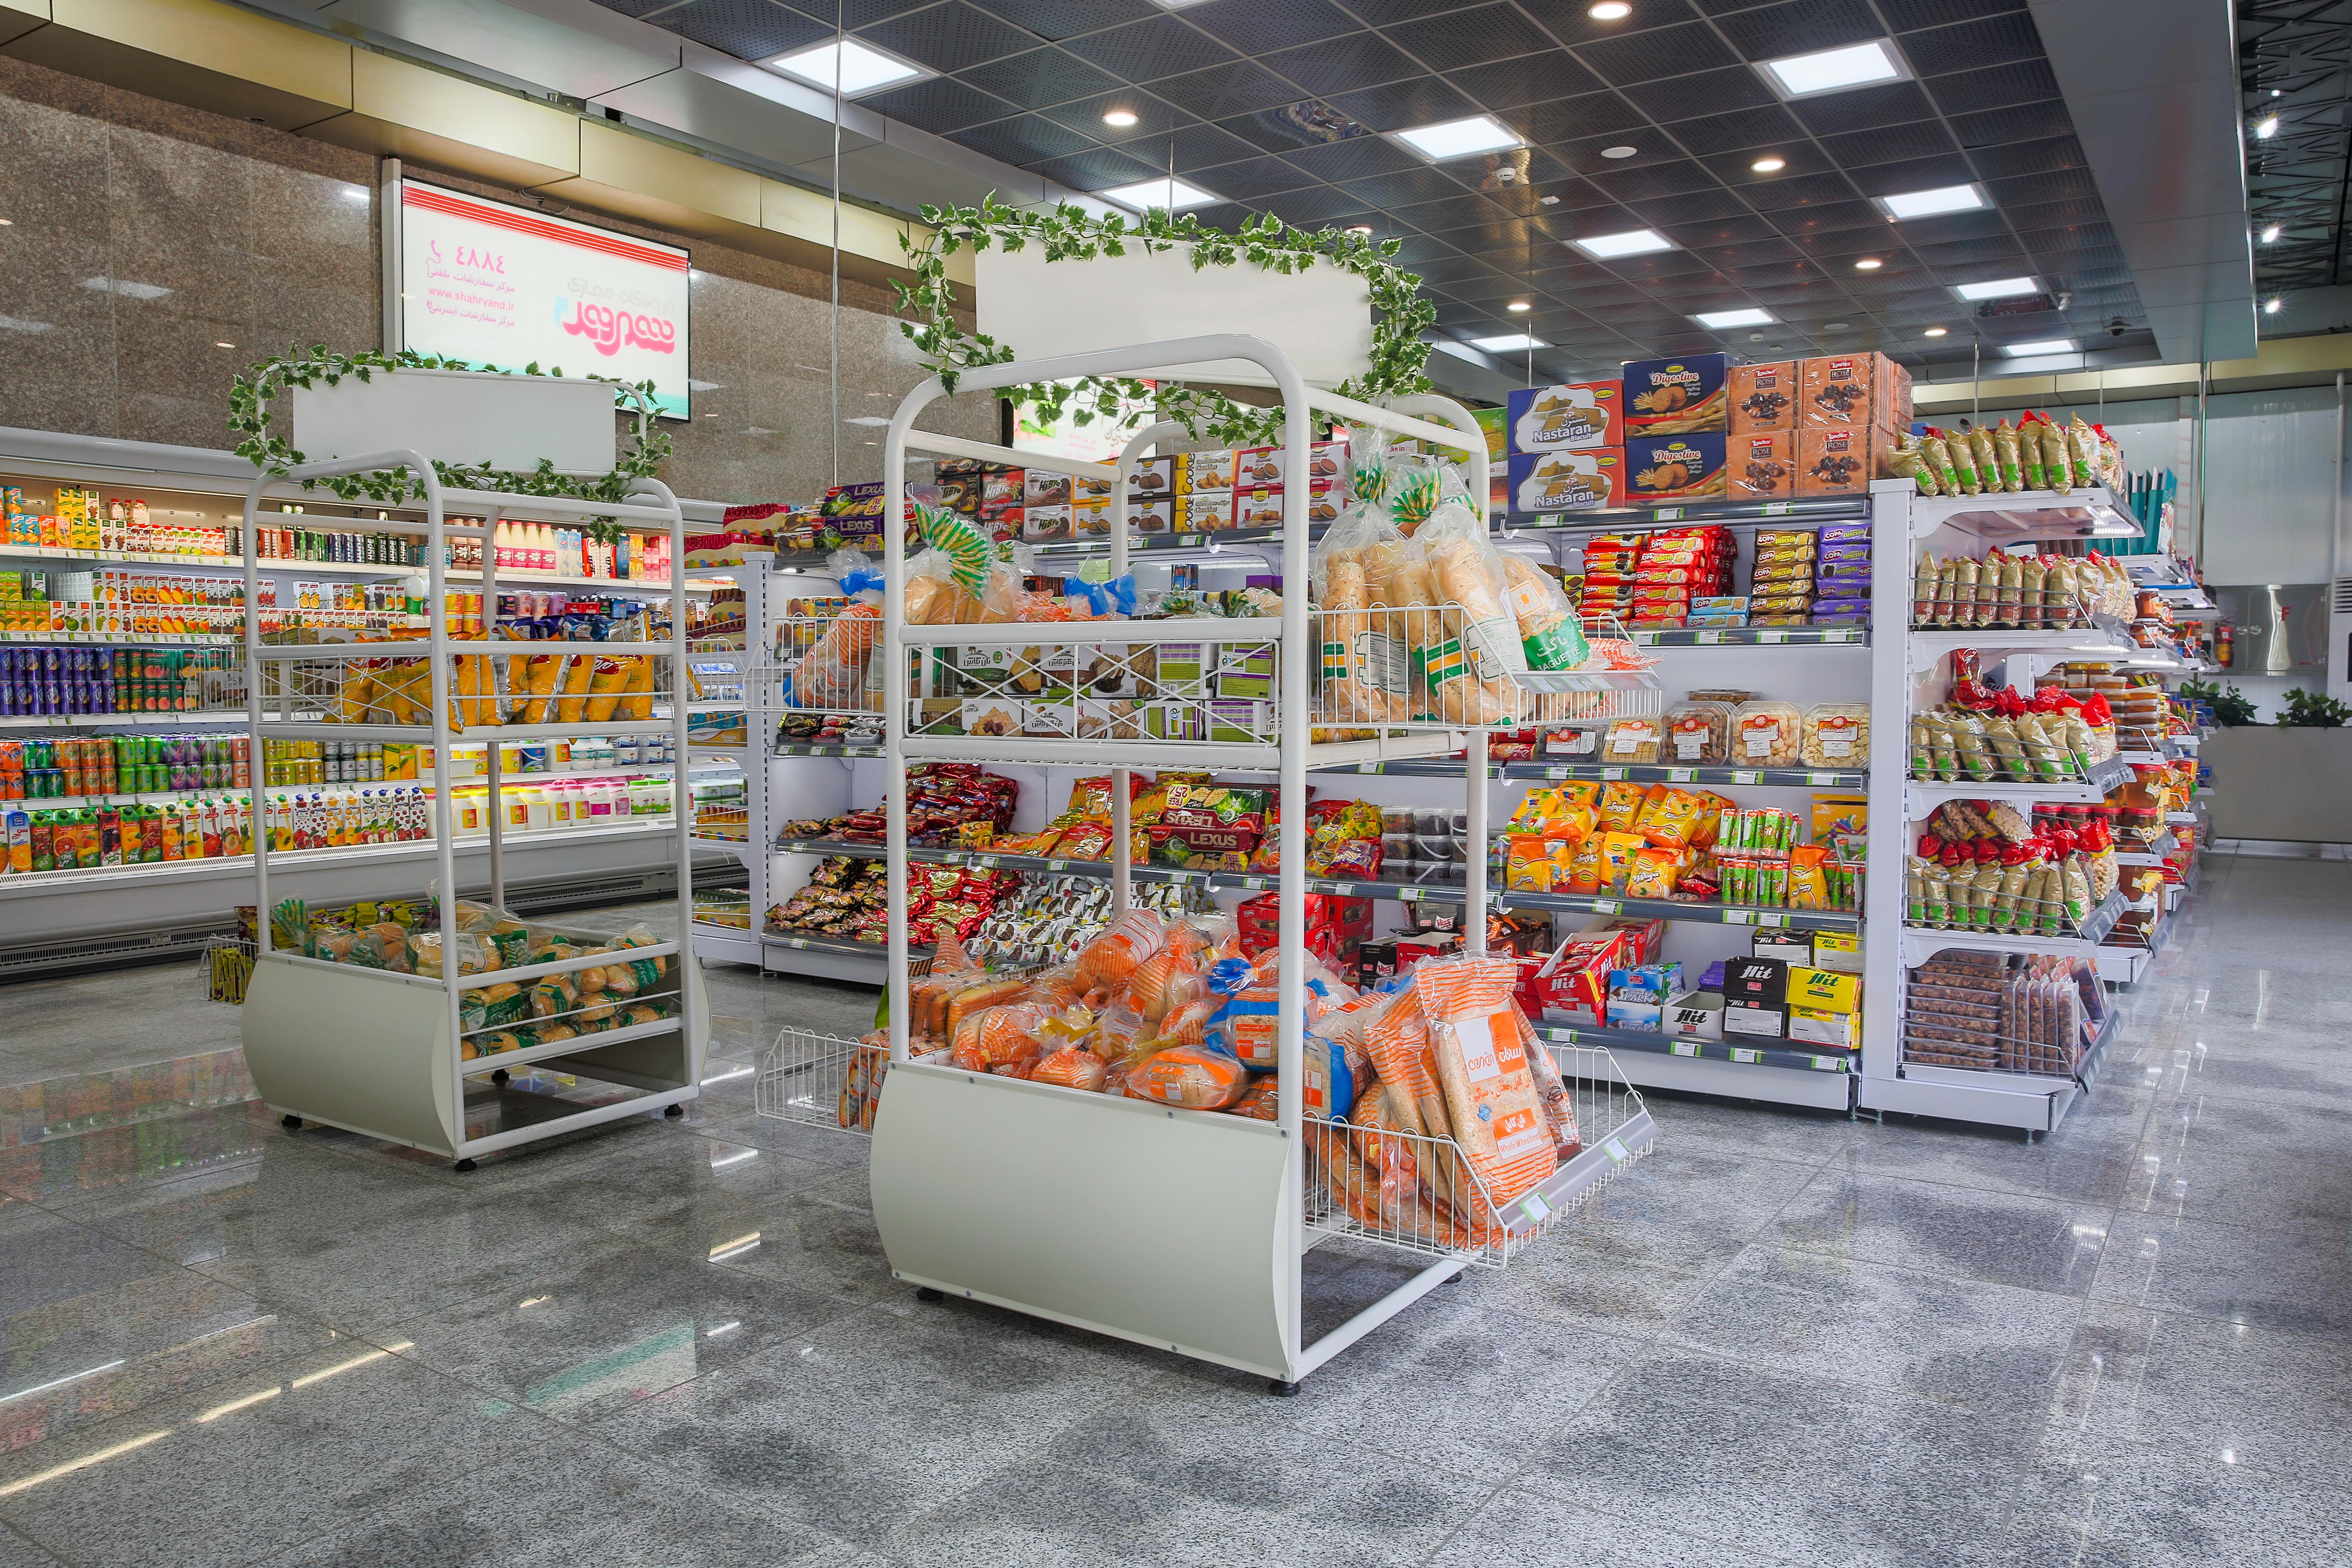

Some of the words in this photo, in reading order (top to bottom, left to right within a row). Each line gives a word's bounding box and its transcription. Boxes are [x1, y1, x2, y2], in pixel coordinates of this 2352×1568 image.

[428, 269, 450, 278] تلفنی
[453, 274, 494, 287] سفارشات
[496, 282, 515, 293] مرکز
[568, 277, 615, 302] مجازی
[428, 287, 514, 312] www.shahrvand.ir
[620, 290, 675, 315] فروشگاه
[460, 310, 496, 322] سفارشات
[498, 317, 515, 327] مرکز
[1653, 372, 1699, 385] Digestive
[1561, 413, 1587, 427] نسترن
[1533, 424, 1591, 443] Nastaran
[1570, 433, 1592, 442] Biscuit
[1655, 450, 1700, 463] Digestive
[1563, 479, 1590, 493] نسترن
[1535, 491, 1594, 508] Nastaran
[1573, 500, 1595, 508] Biscuit
[840, 520, 875, 531] LEXUS
[1825, 530, 1842, 539] COPA
[1536, 646, 1580, 670] BAGUETTE
[1166, 812, 1213, 827] LEXUS
[1190, 832, 1237, 846] LEXUS
[1225, 854, 1239, 862] FREE
[1601, 956, 1613, 980] Hit
[1739, 965, 1772, 979] Hit
[1550, 977, 1577, 991] Hit
[1806, 973, 1839, 987] Hit
[1618, 988, 1653, 1003] SPARK
[1673, 1009, 1707, 1023] Hit
[1505, 1118, 1516, 1133] کامل
[1517, 1114, 1526, 1128] نان
[1499, 1140, 1516, 1153] Whole
